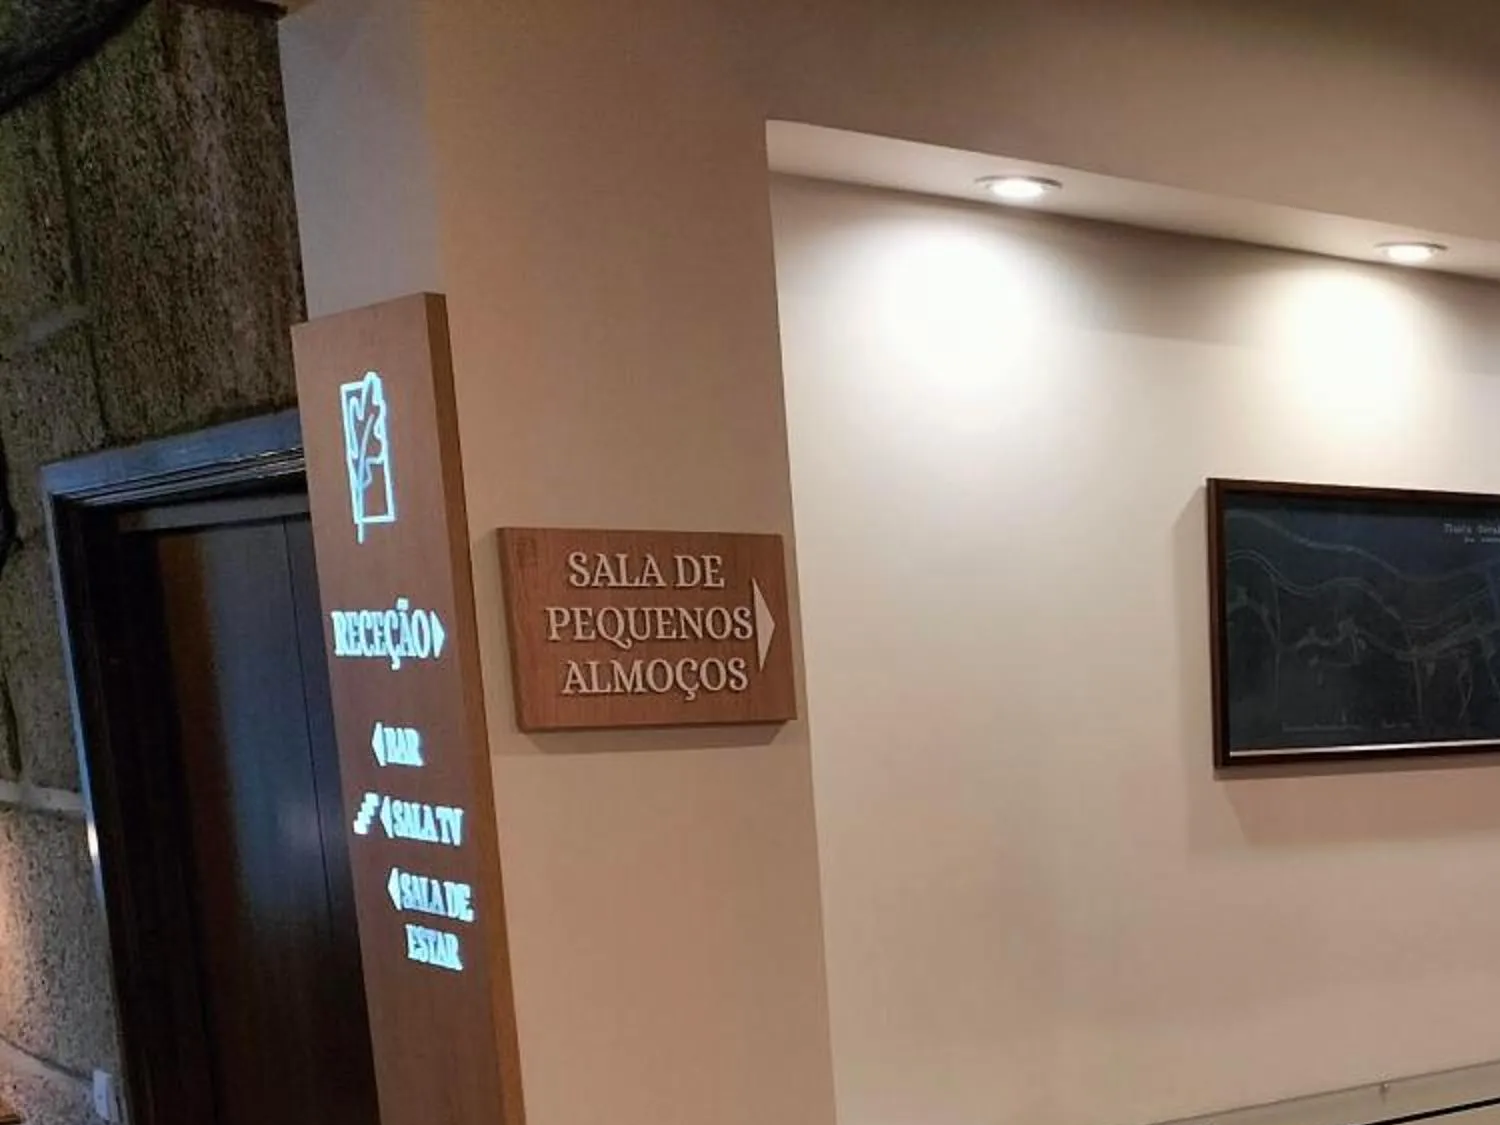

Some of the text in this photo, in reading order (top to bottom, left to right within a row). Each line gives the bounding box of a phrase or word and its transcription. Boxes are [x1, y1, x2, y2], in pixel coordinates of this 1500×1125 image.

[567, 552, 726, 590] SALA DE
[331, 597, 433, 670] RECEÇÃO
[545, 605, 753, 649] PEQUENOS
[561, 656, 749, 701] ALMOÇOS
[383, 726, 423, 767] BAR
[391, 799, 463, 847] SALA TV
[400, 873, 475, 922] SALA DE
[405, 924, 463, 971] ESTAR
